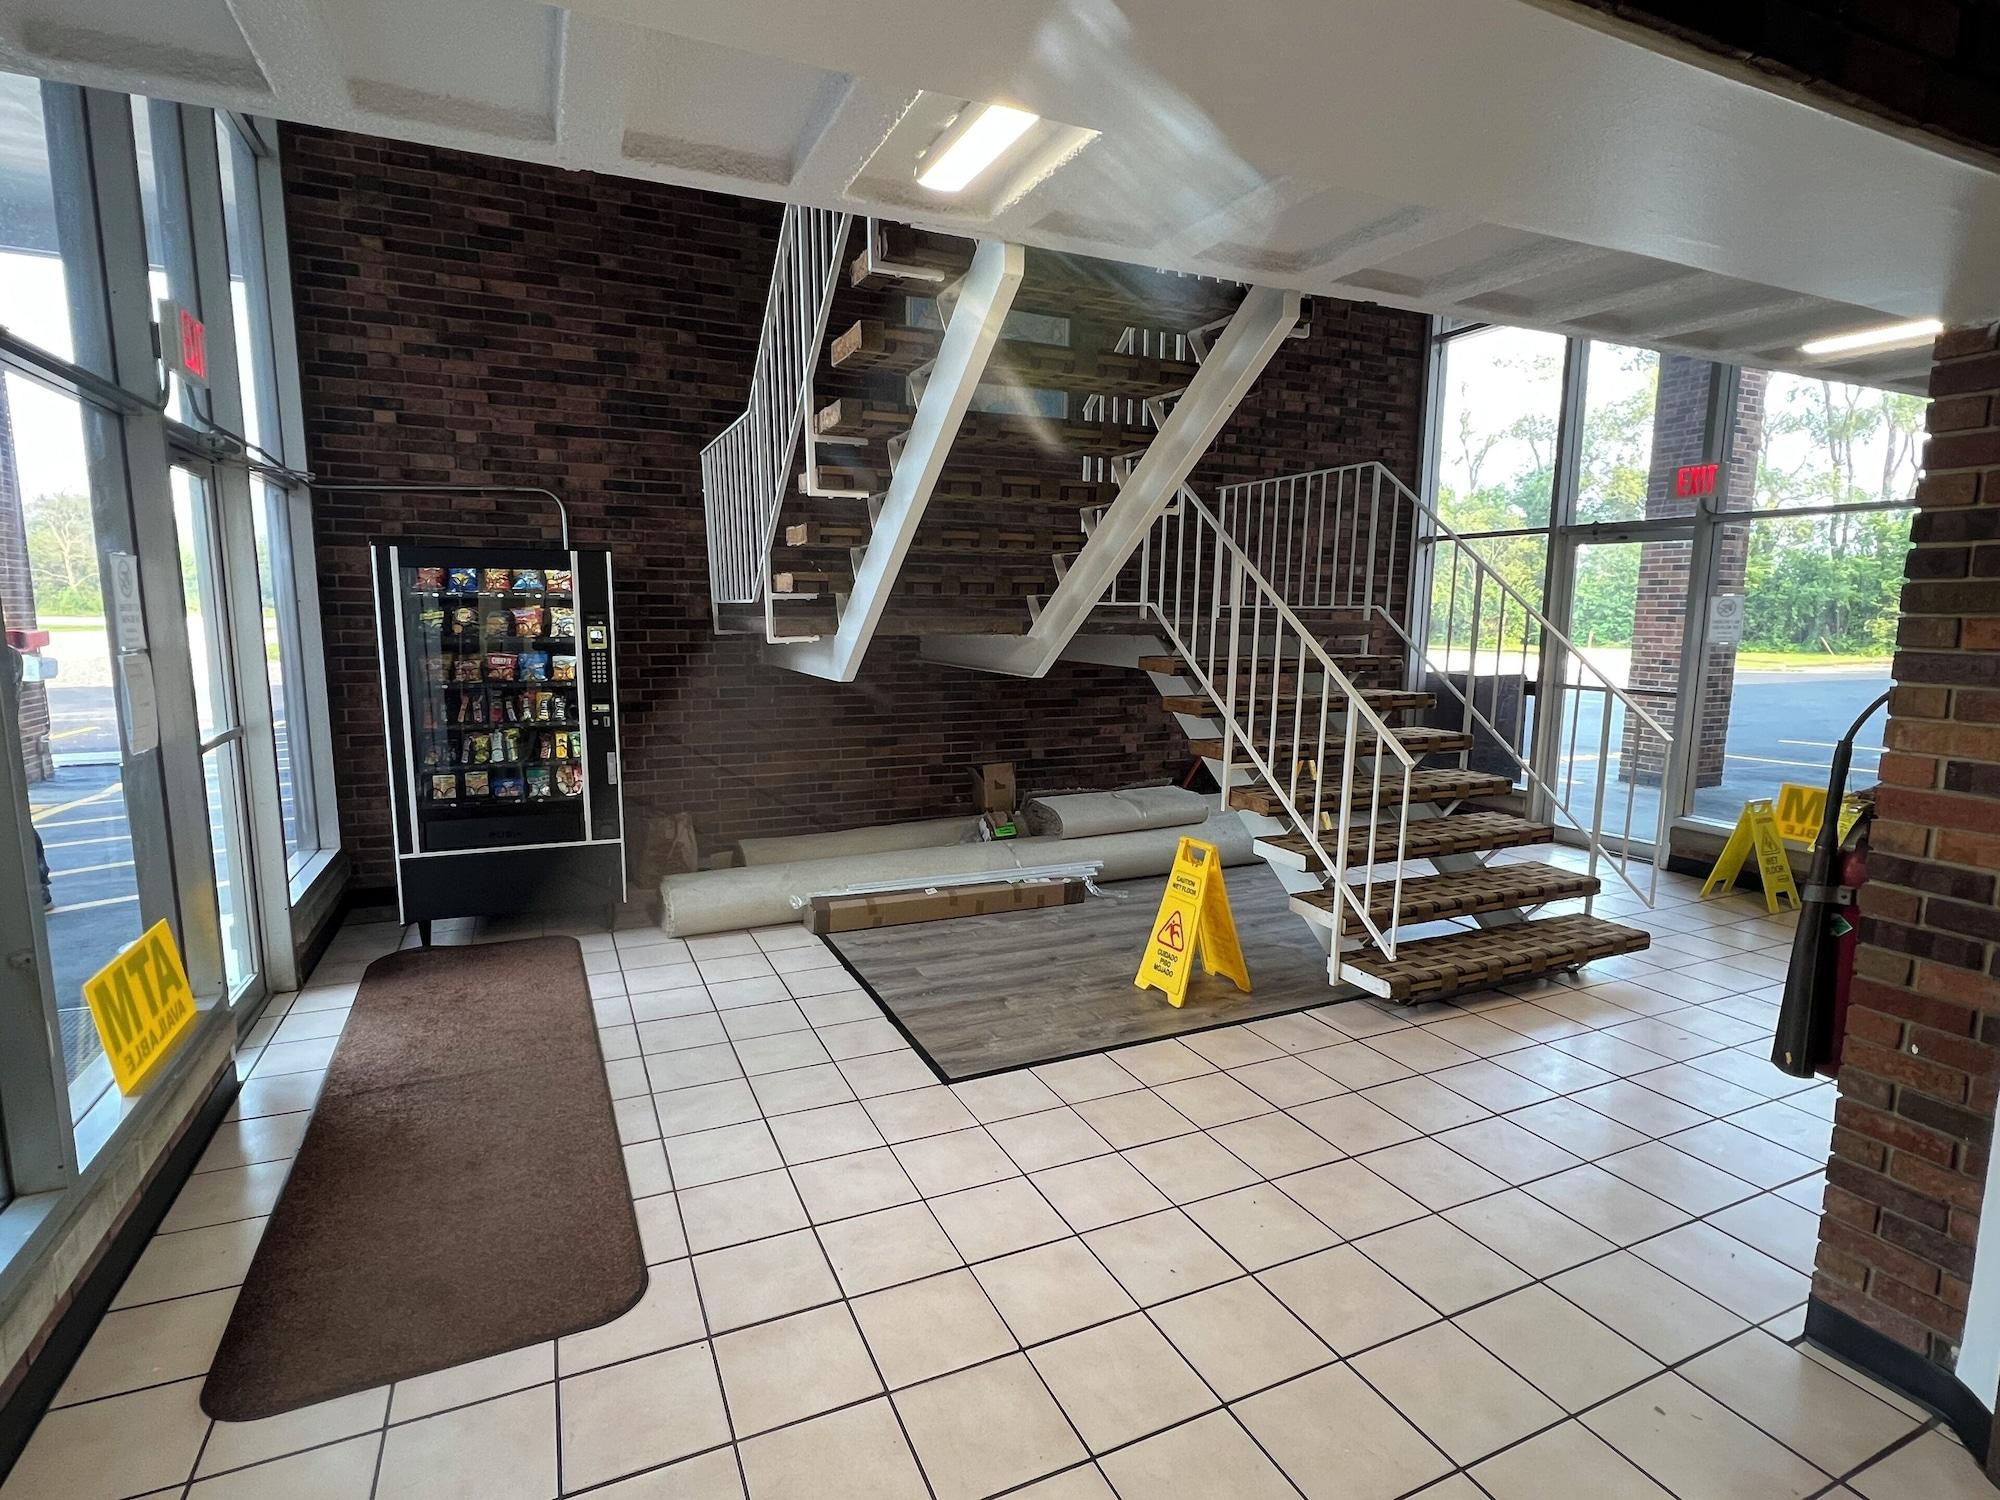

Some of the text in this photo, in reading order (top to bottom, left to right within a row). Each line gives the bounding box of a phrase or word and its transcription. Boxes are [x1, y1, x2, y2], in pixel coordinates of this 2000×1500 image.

[1676, 464, 1719, 497] EXIT
[1176, 875, 1196, 887] CAUTION
[1173, 882, 1197, 896] WET FLOOR
[1157, 949, 1178, 962] CUIDADO
[1160, 957, 1171, 968] PISO
[1154, 963, 1173, 977] MOJADO
